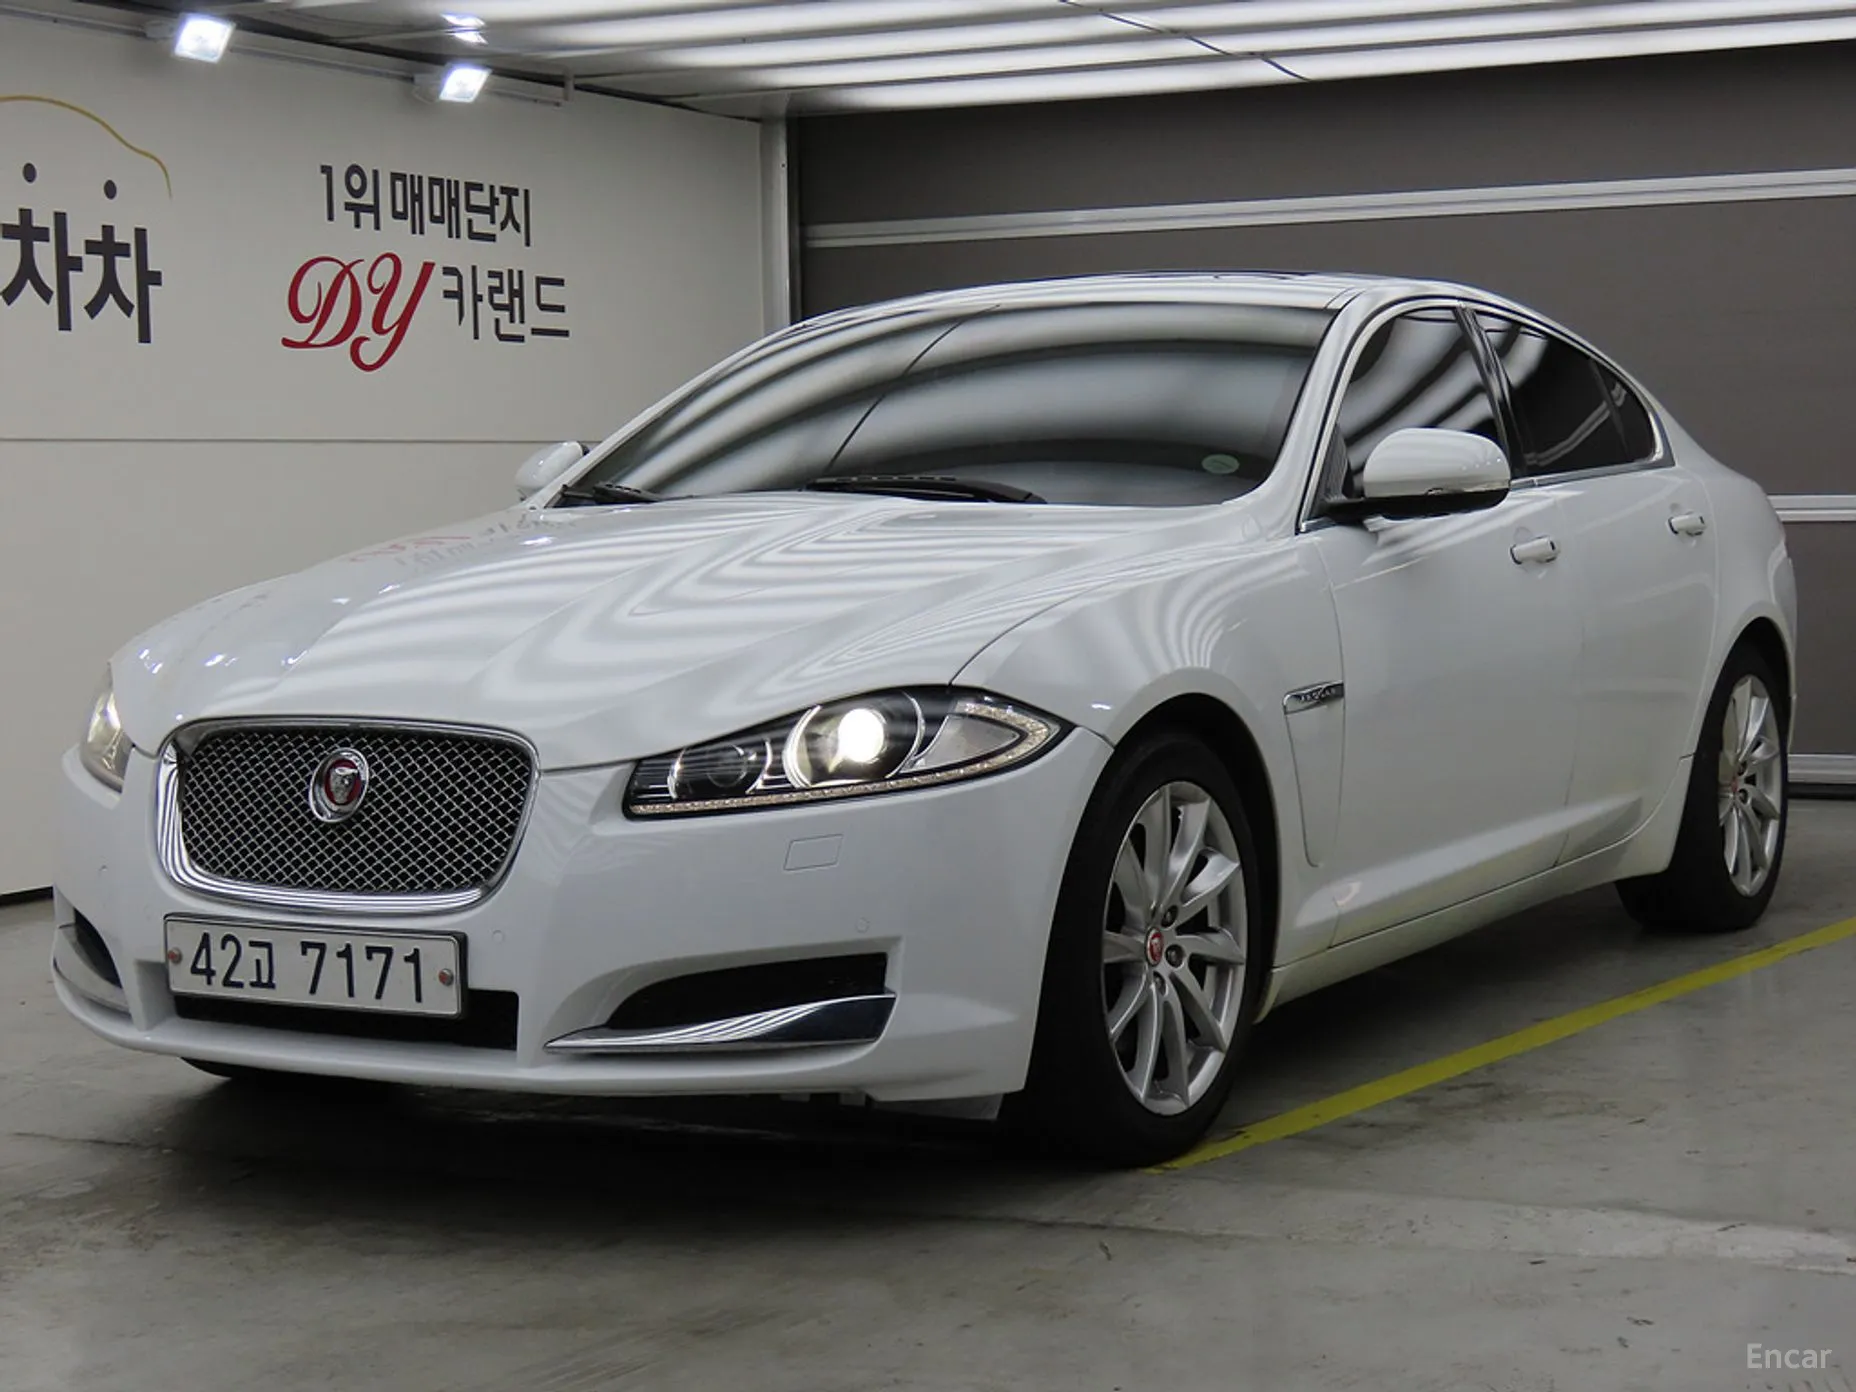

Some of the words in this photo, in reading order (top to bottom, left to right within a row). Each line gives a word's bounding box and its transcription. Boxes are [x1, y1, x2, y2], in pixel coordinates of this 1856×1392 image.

[320, 164, 381, 231] 1위
[390, 172, 531, 247] 매매단지
[281, 252, 435, 372] DY
[442, 264, 570, 343] 카랜드
[189, 931, 276, 989] 42고
[300, 940, 423, 1003] 7171
